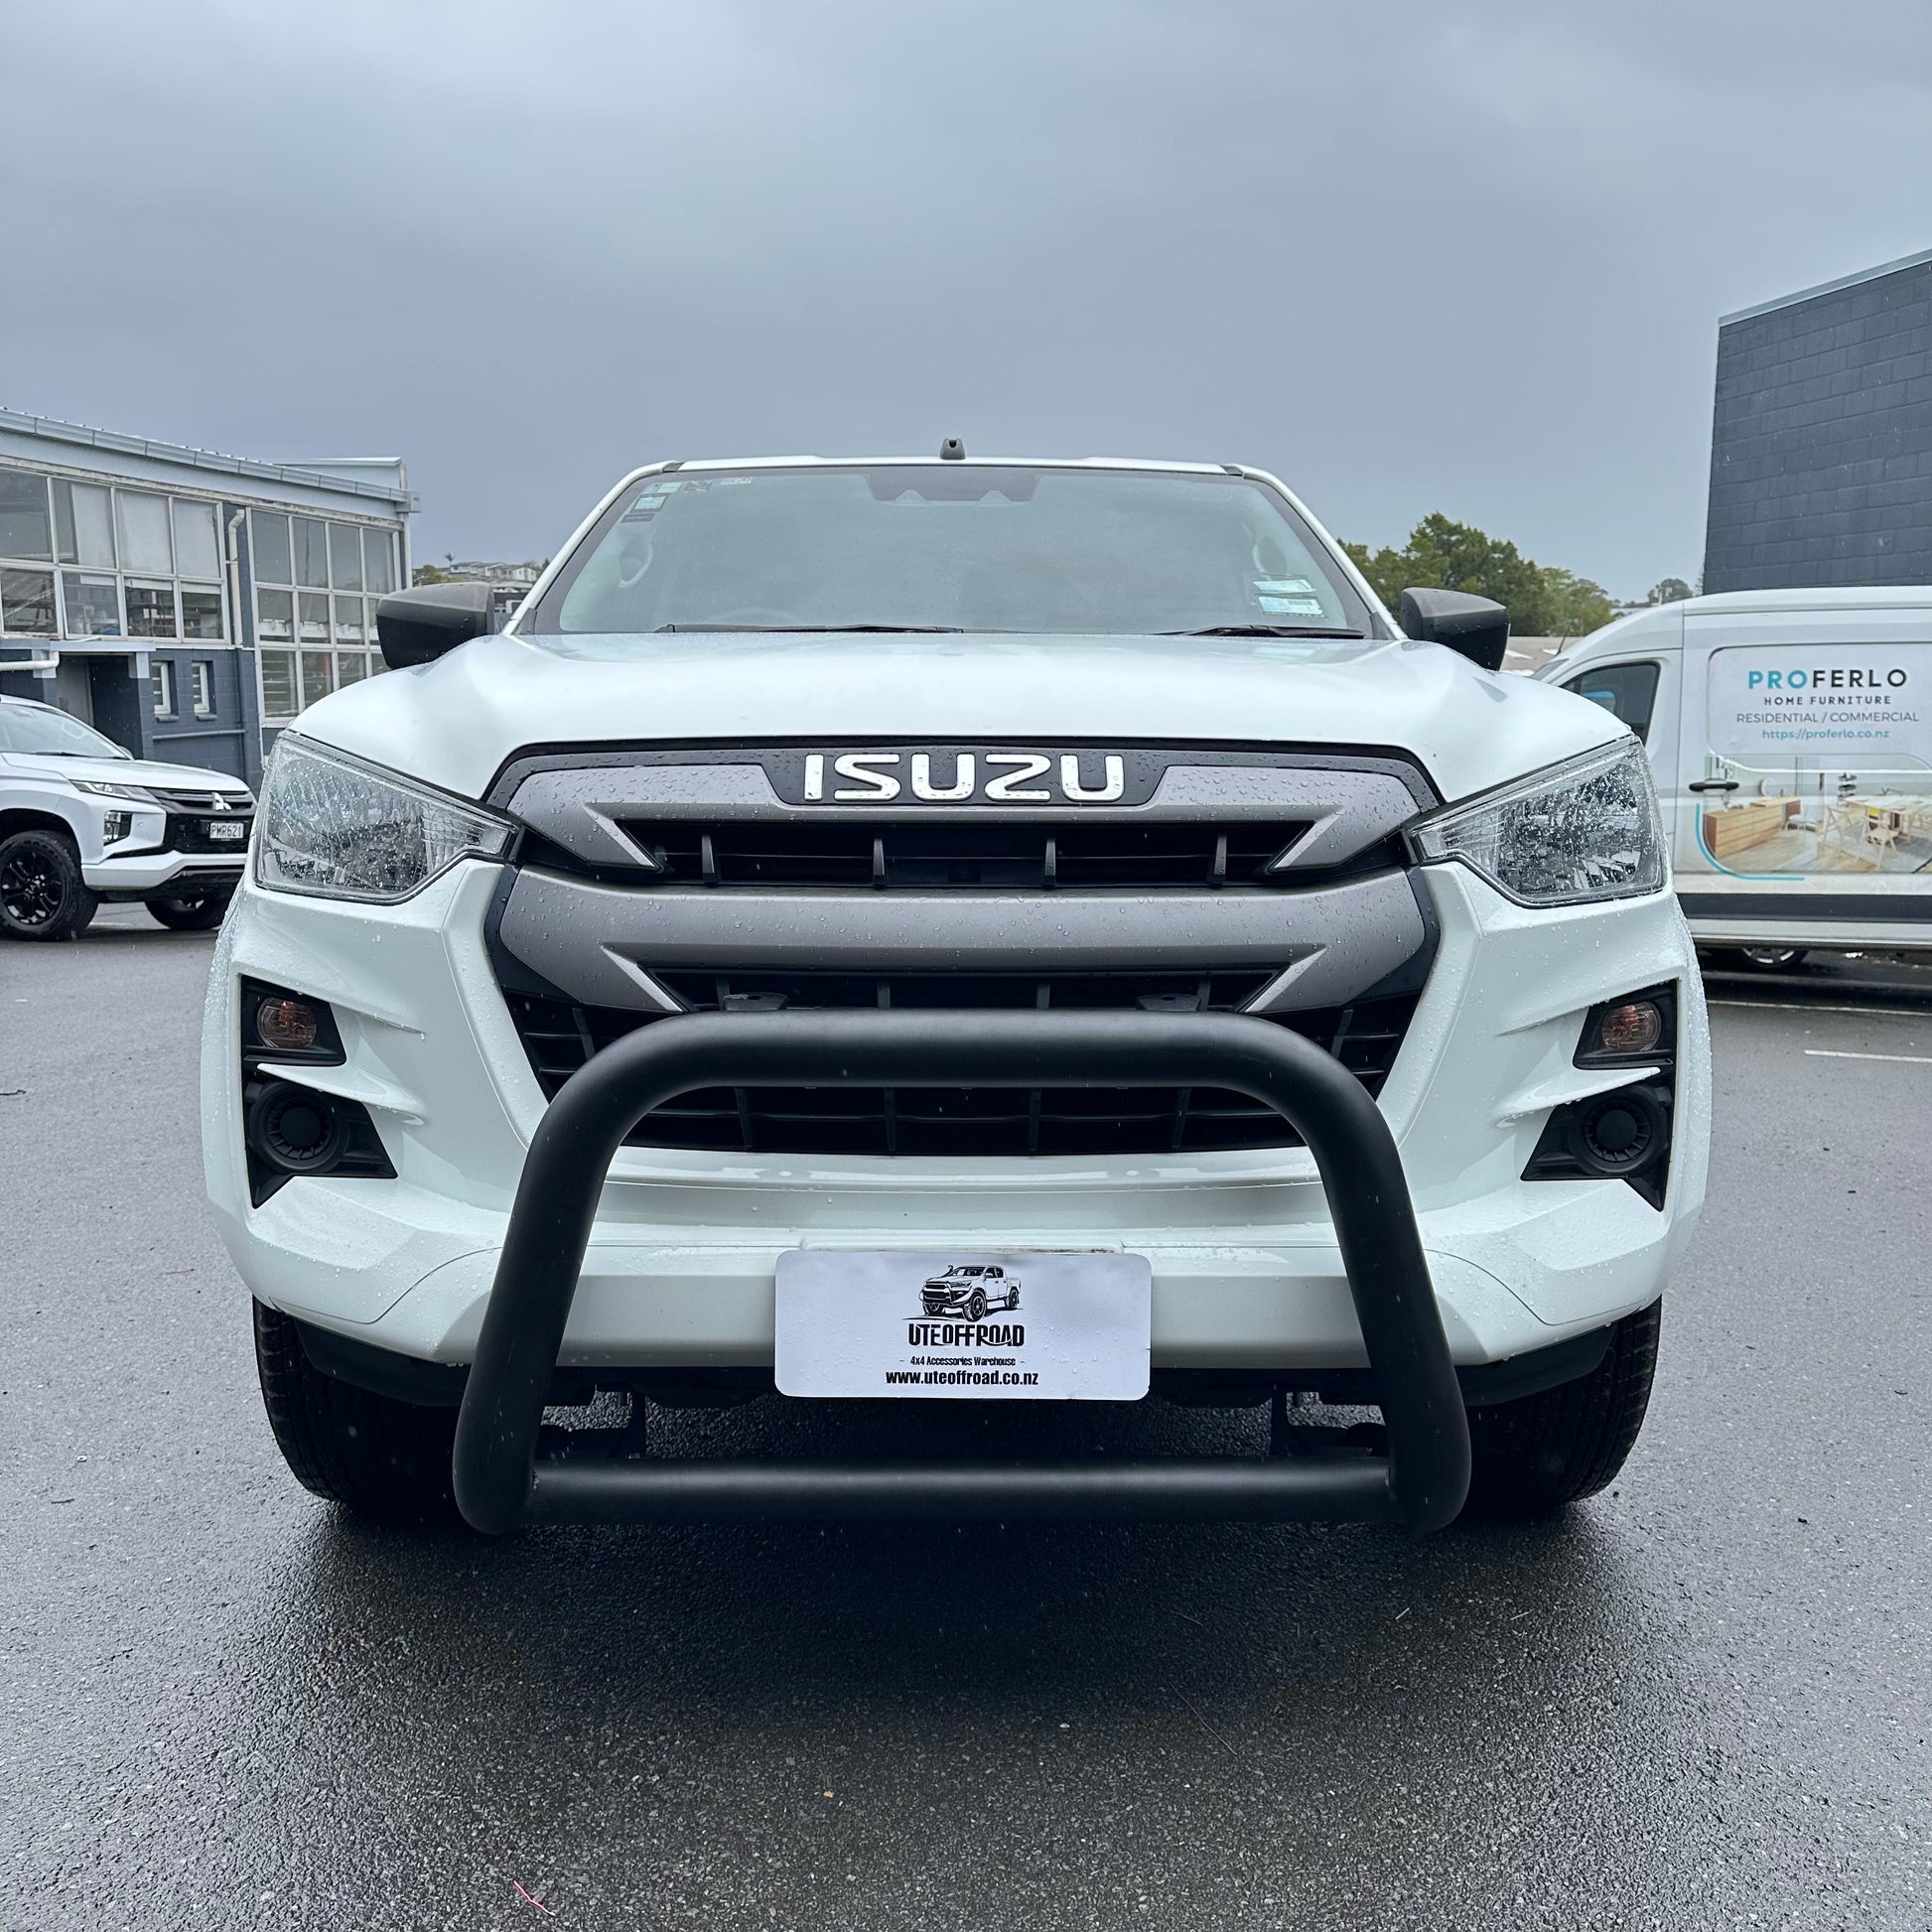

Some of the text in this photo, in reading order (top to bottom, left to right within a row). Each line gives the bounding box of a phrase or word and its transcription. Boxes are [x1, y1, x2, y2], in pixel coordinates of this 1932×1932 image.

[1747, 669, 1907, 689] PROFERLO
[1764, 696, 1891, 706] HOME FURNITURE
[1736, 713, 1819, 724] RESIDENTIAL
[1830, 712, 1919, 723] COMMERCIAL
[1762, 729, 1890, 741] https://proferlo.co.nz
[803, 753, 1125, 802] ISUZU
[211, 825, 241, 837] PMR621
[908, 1323, 1025, 1346] UTEOFFROAD
[910, 1356, 1016, 1366] 4x4 Accessories Warehouse
[886, 1370, 1038, 1385] www.uteoffroad.co.nz
